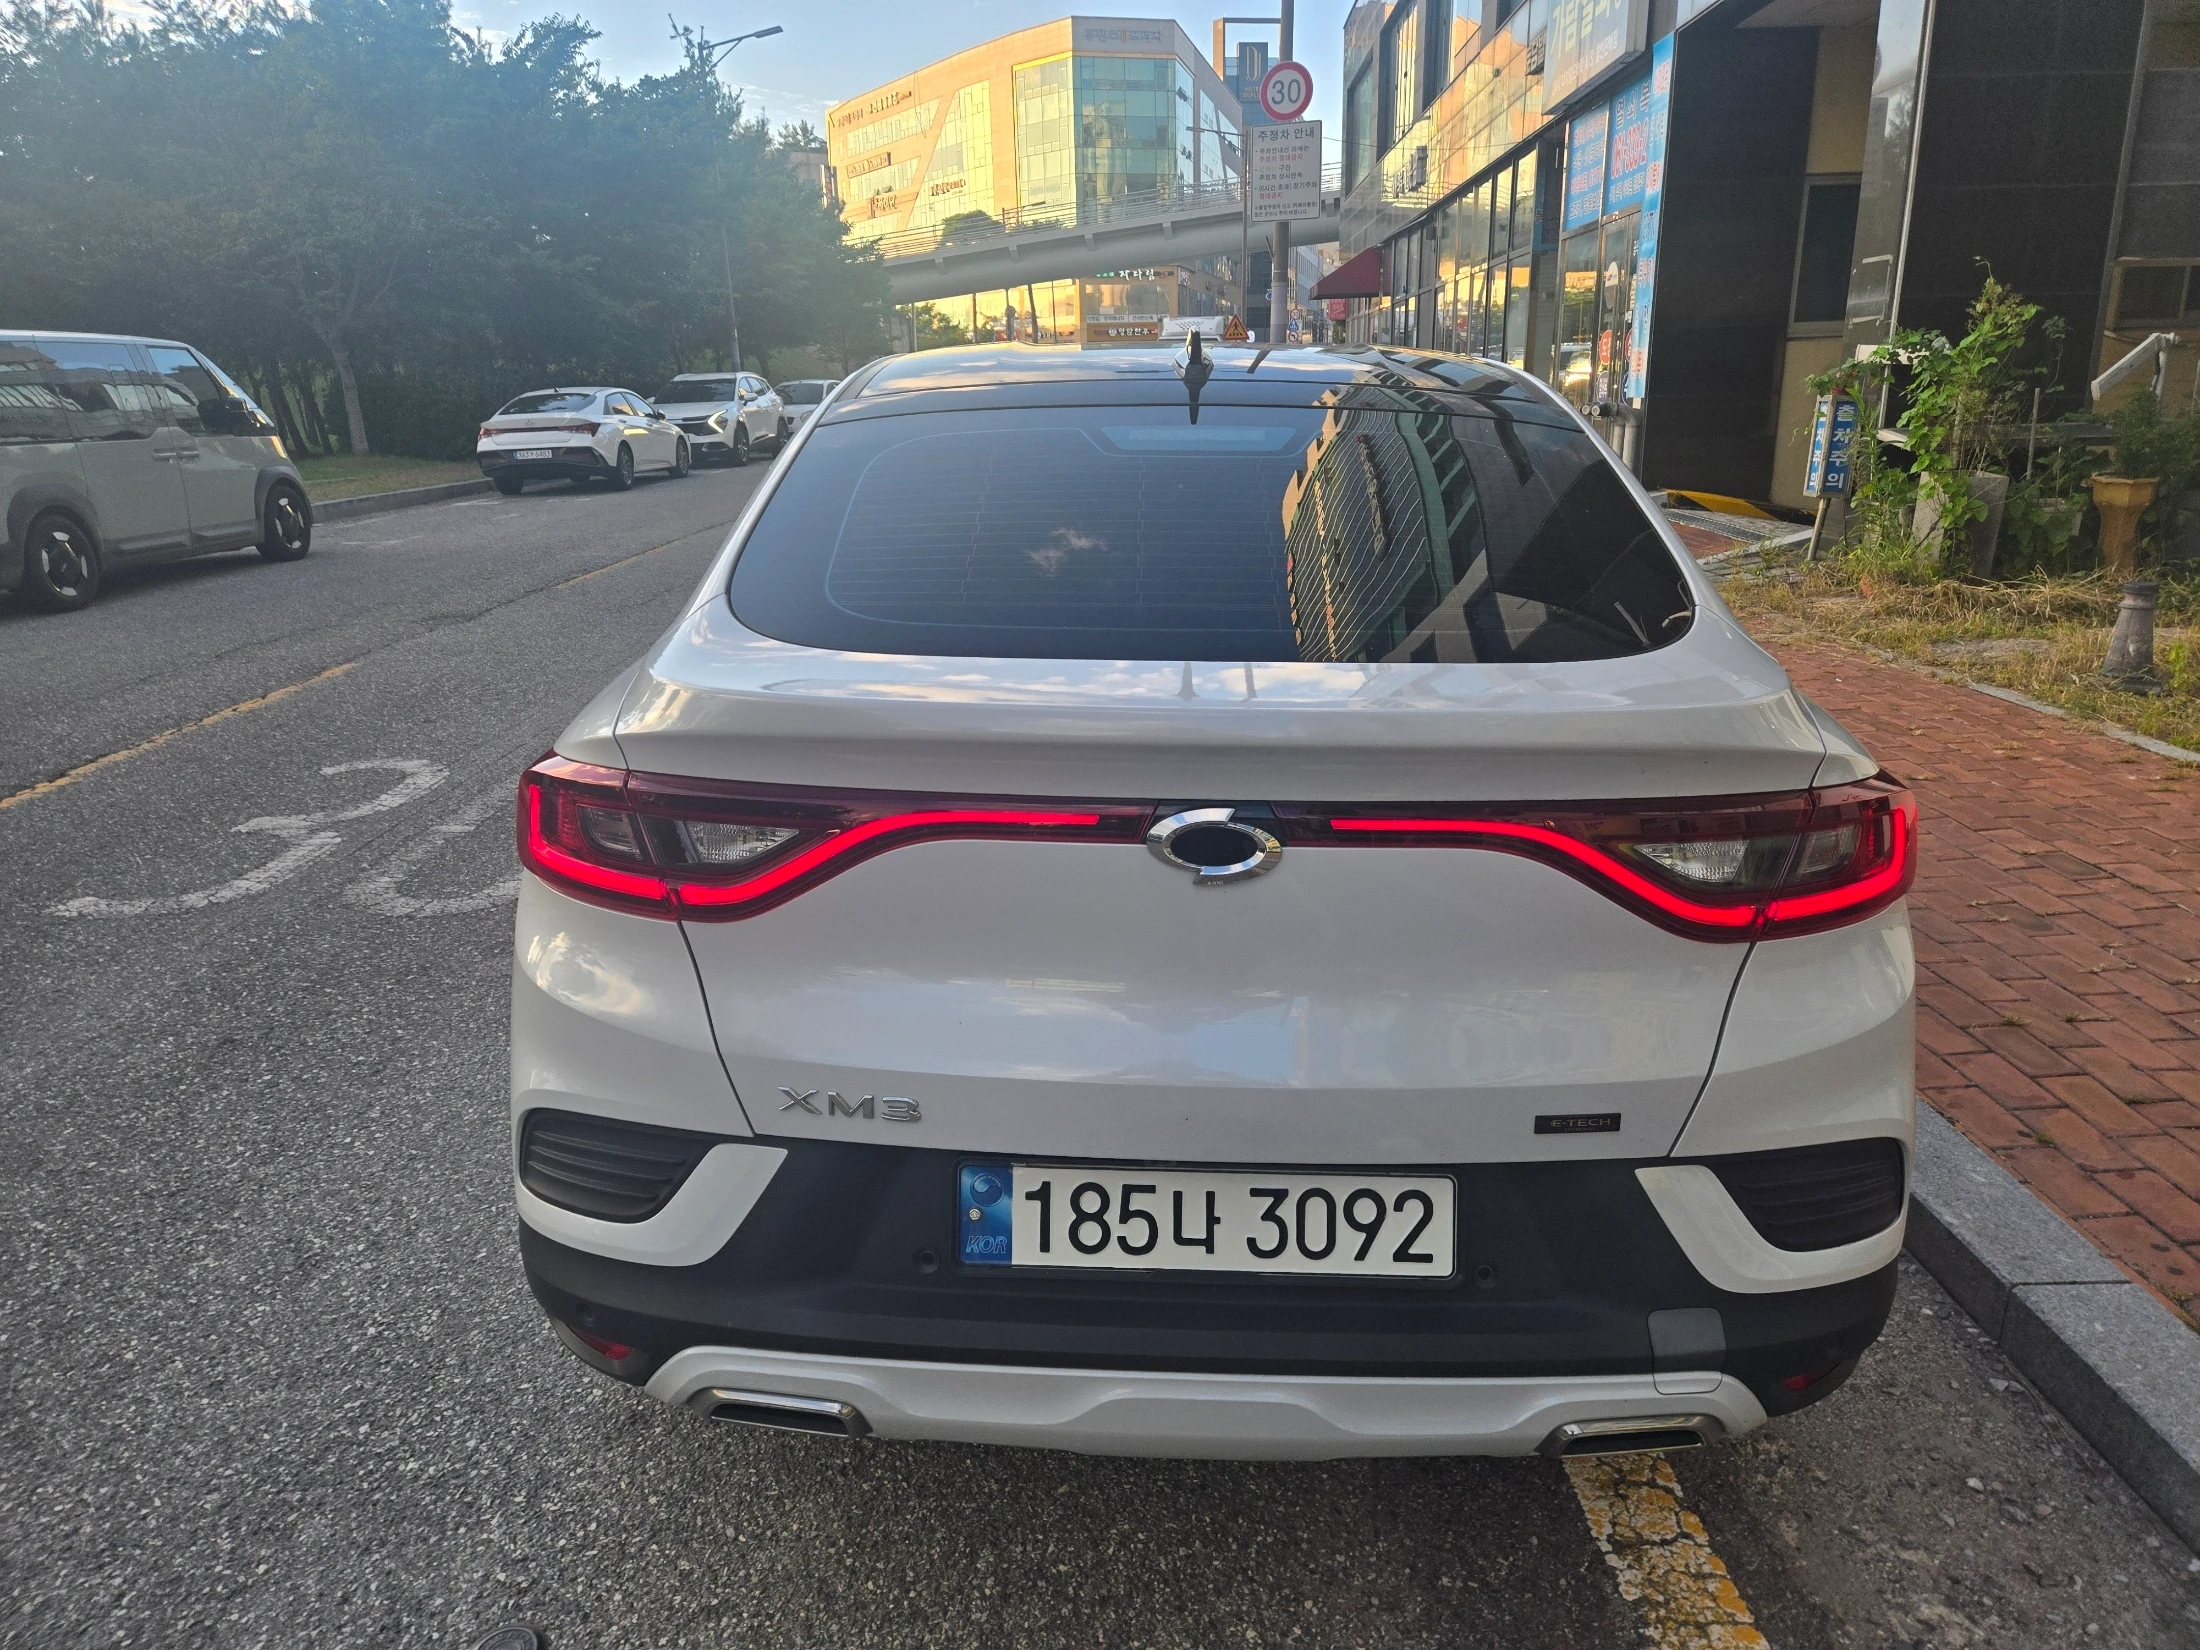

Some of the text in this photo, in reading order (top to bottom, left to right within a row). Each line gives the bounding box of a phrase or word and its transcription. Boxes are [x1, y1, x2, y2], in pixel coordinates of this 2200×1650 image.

[1271, 79, 1301, 105] 30
[1258, 126, 1315, 142] 주정차 안내
[1279, 164, 1291, 172] 구간
[1259, 173, 1276, 181] 주정차
[1119, 327, 1150, 336] 영암한우
[1825, 404, 1857, 489] 출차주의
[777, 1086, 922, 1122] XM3
[1551, 1118, 1611, 1127] E-TECH
[1024, 1181, 1434, 1264] 185나 3092
[966, 1235, 1008, 1254] KOR
